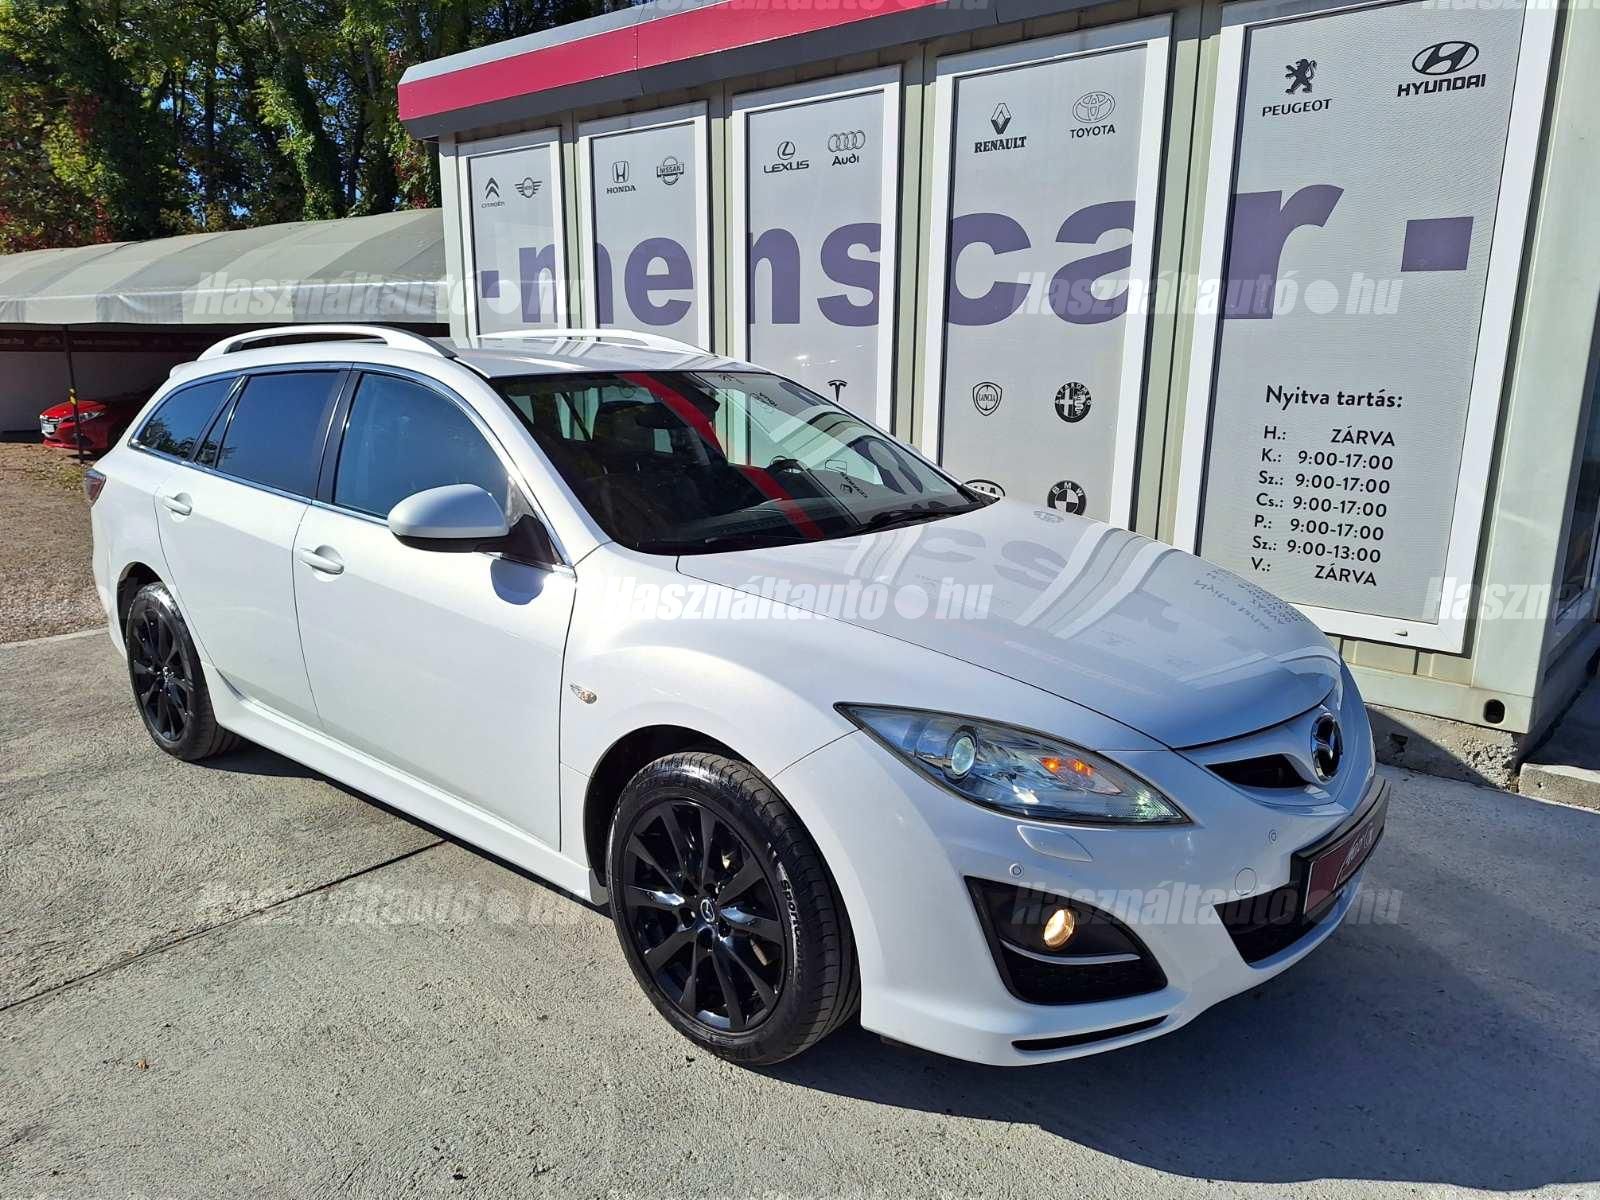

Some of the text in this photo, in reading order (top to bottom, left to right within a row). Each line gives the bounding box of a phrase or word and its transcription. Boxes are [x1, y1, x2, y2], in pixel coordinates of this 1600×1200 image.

[1397, 74, 1487, 97] HYUNDAI
[1262, 98, 1332, 117] PEUGEOT
[1069, 124, 1116, 139] TOYOTA
[974, 136, 1027, 153] RENAULT
[659, 165, 681, 174] NISSAN
[763, 160, 810, 174] LEXUS
[832, 153, 860, 166] Audi
[606, 184, 636, 194] HONDA
[1265, 384, 1403, 411] Nyitva tartás:
[1263, 425, 1396, 447] H.: ZÁRVA
[1260, 447, 1394, 470] K.: 9:00-17:00
[1051, 481, 1085, 498] BMW
[1258, 470, 1391, 494] Sz.: 9:00-17:00
[1256, 492, 1387, 518] Cs.: 9:00-17:00
[1254, 514, 1384, 541] P.: 9:00-17:00
[1251, 535, 1382, 563] Sz.: 9:00-13:00
[1250, 556, 1377, 586] V.: ZÁRVA
